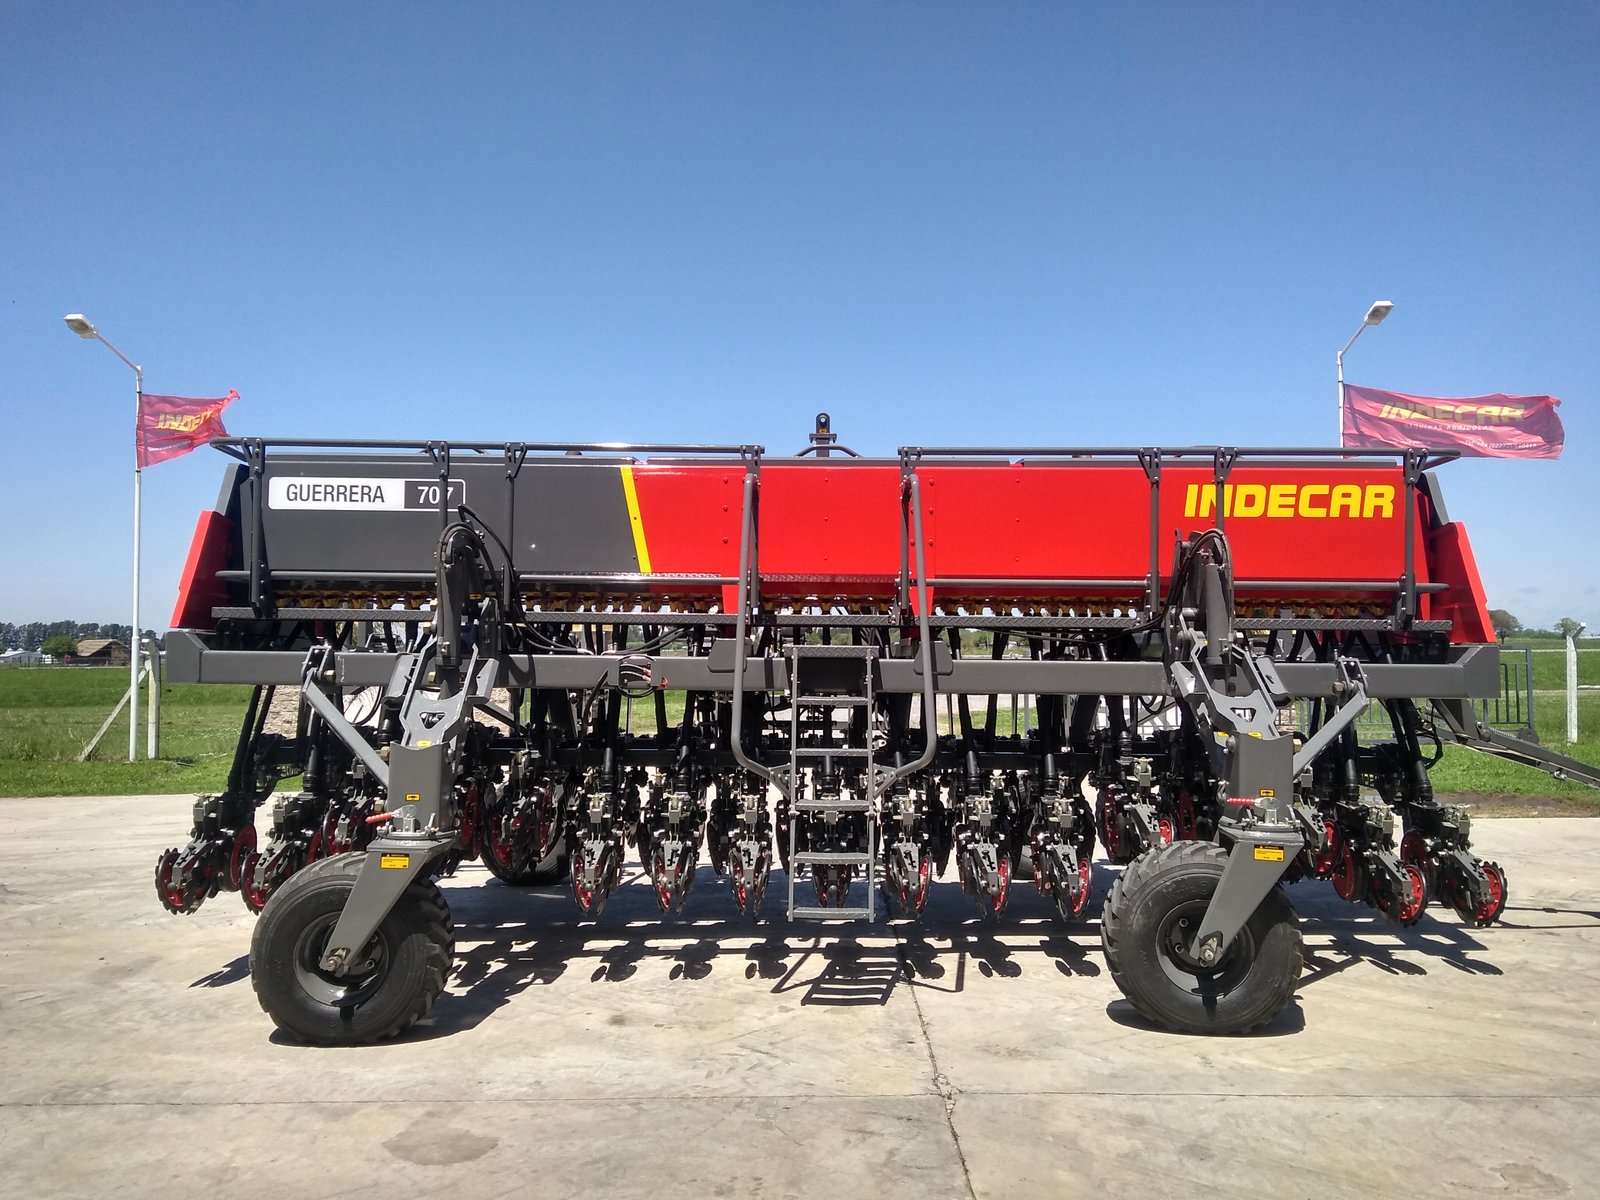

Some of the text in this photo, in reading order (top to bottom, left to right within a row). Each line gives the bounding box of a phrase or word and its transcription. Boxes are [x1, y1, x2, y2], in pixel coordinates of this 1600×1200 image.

[1379, 402, 1524, 425] INDECAR
[286, 483, 385, 503] GUERRERA
[1184, 484, 1395, 518] INDECAR
